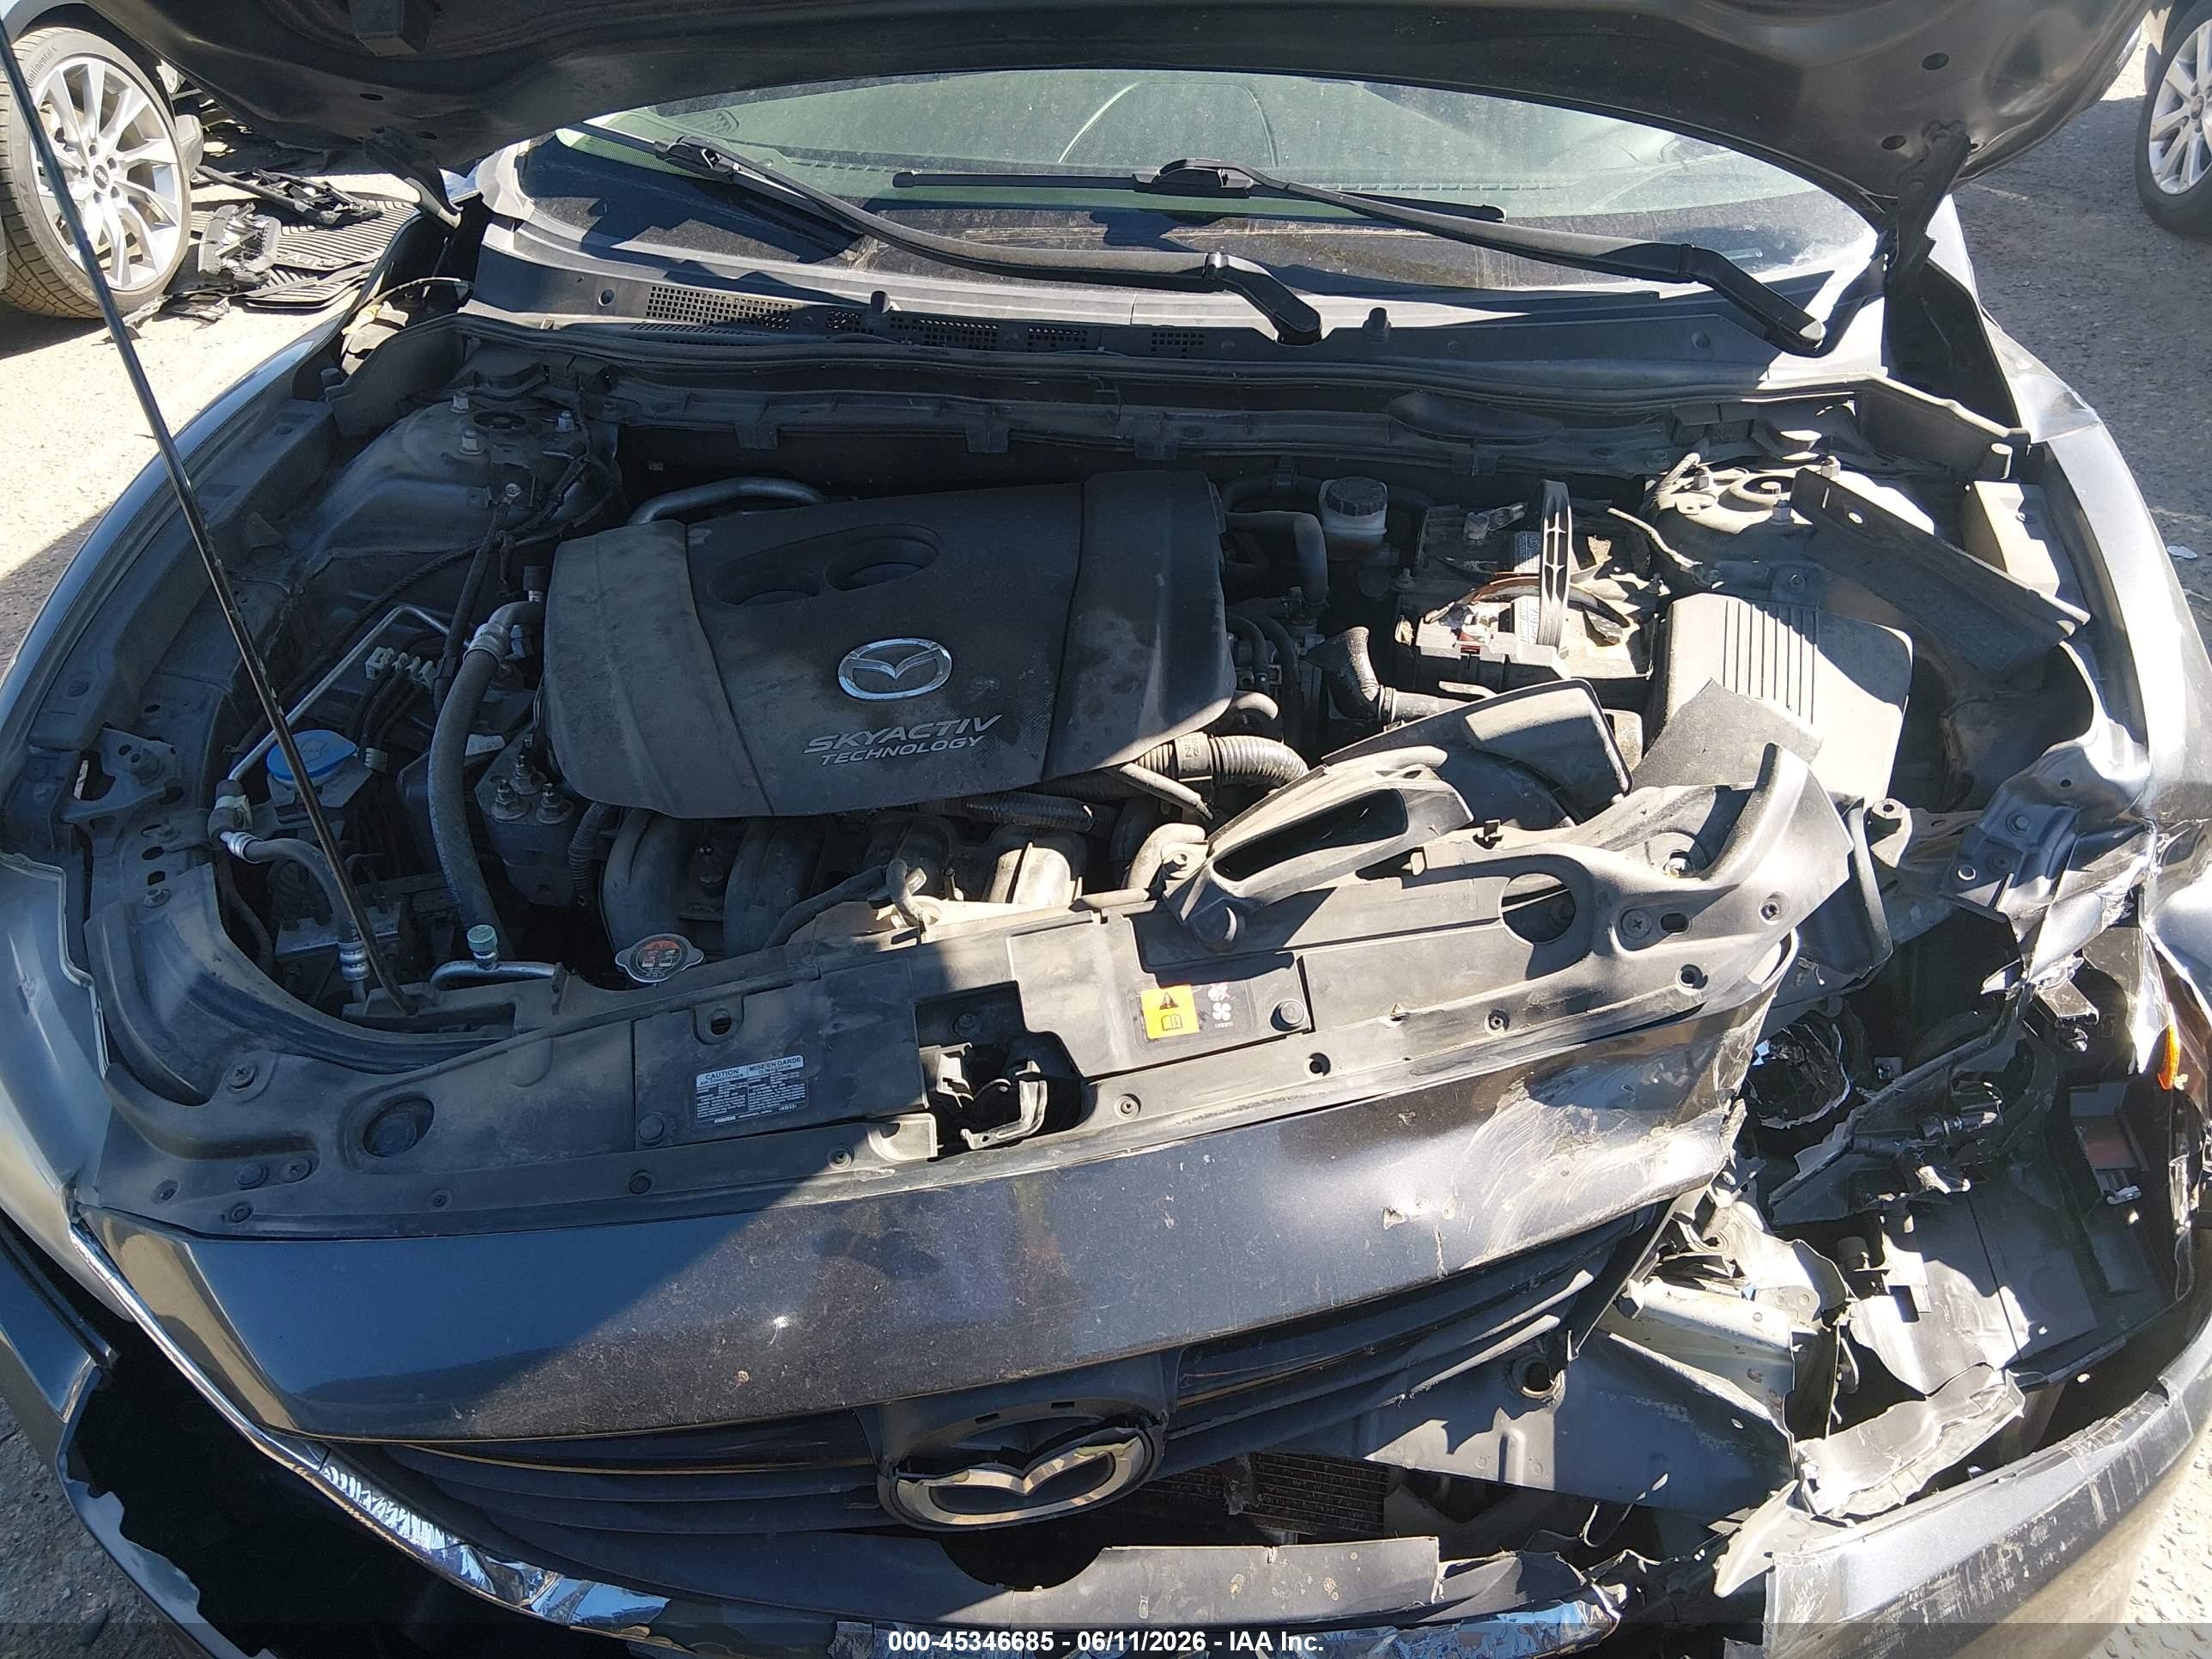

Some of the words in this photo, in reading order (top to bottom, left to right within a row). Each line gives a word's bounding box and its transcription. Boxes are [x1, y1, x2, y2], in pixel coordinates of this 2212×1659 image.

[803, 714, 1003, 754] SKYACTIV
[821, 734, 987, 766] TECHNOLOGY
[777, 1056, 801, 1066] GARDE
[705, 1067, 739, 1081] CAUTION
